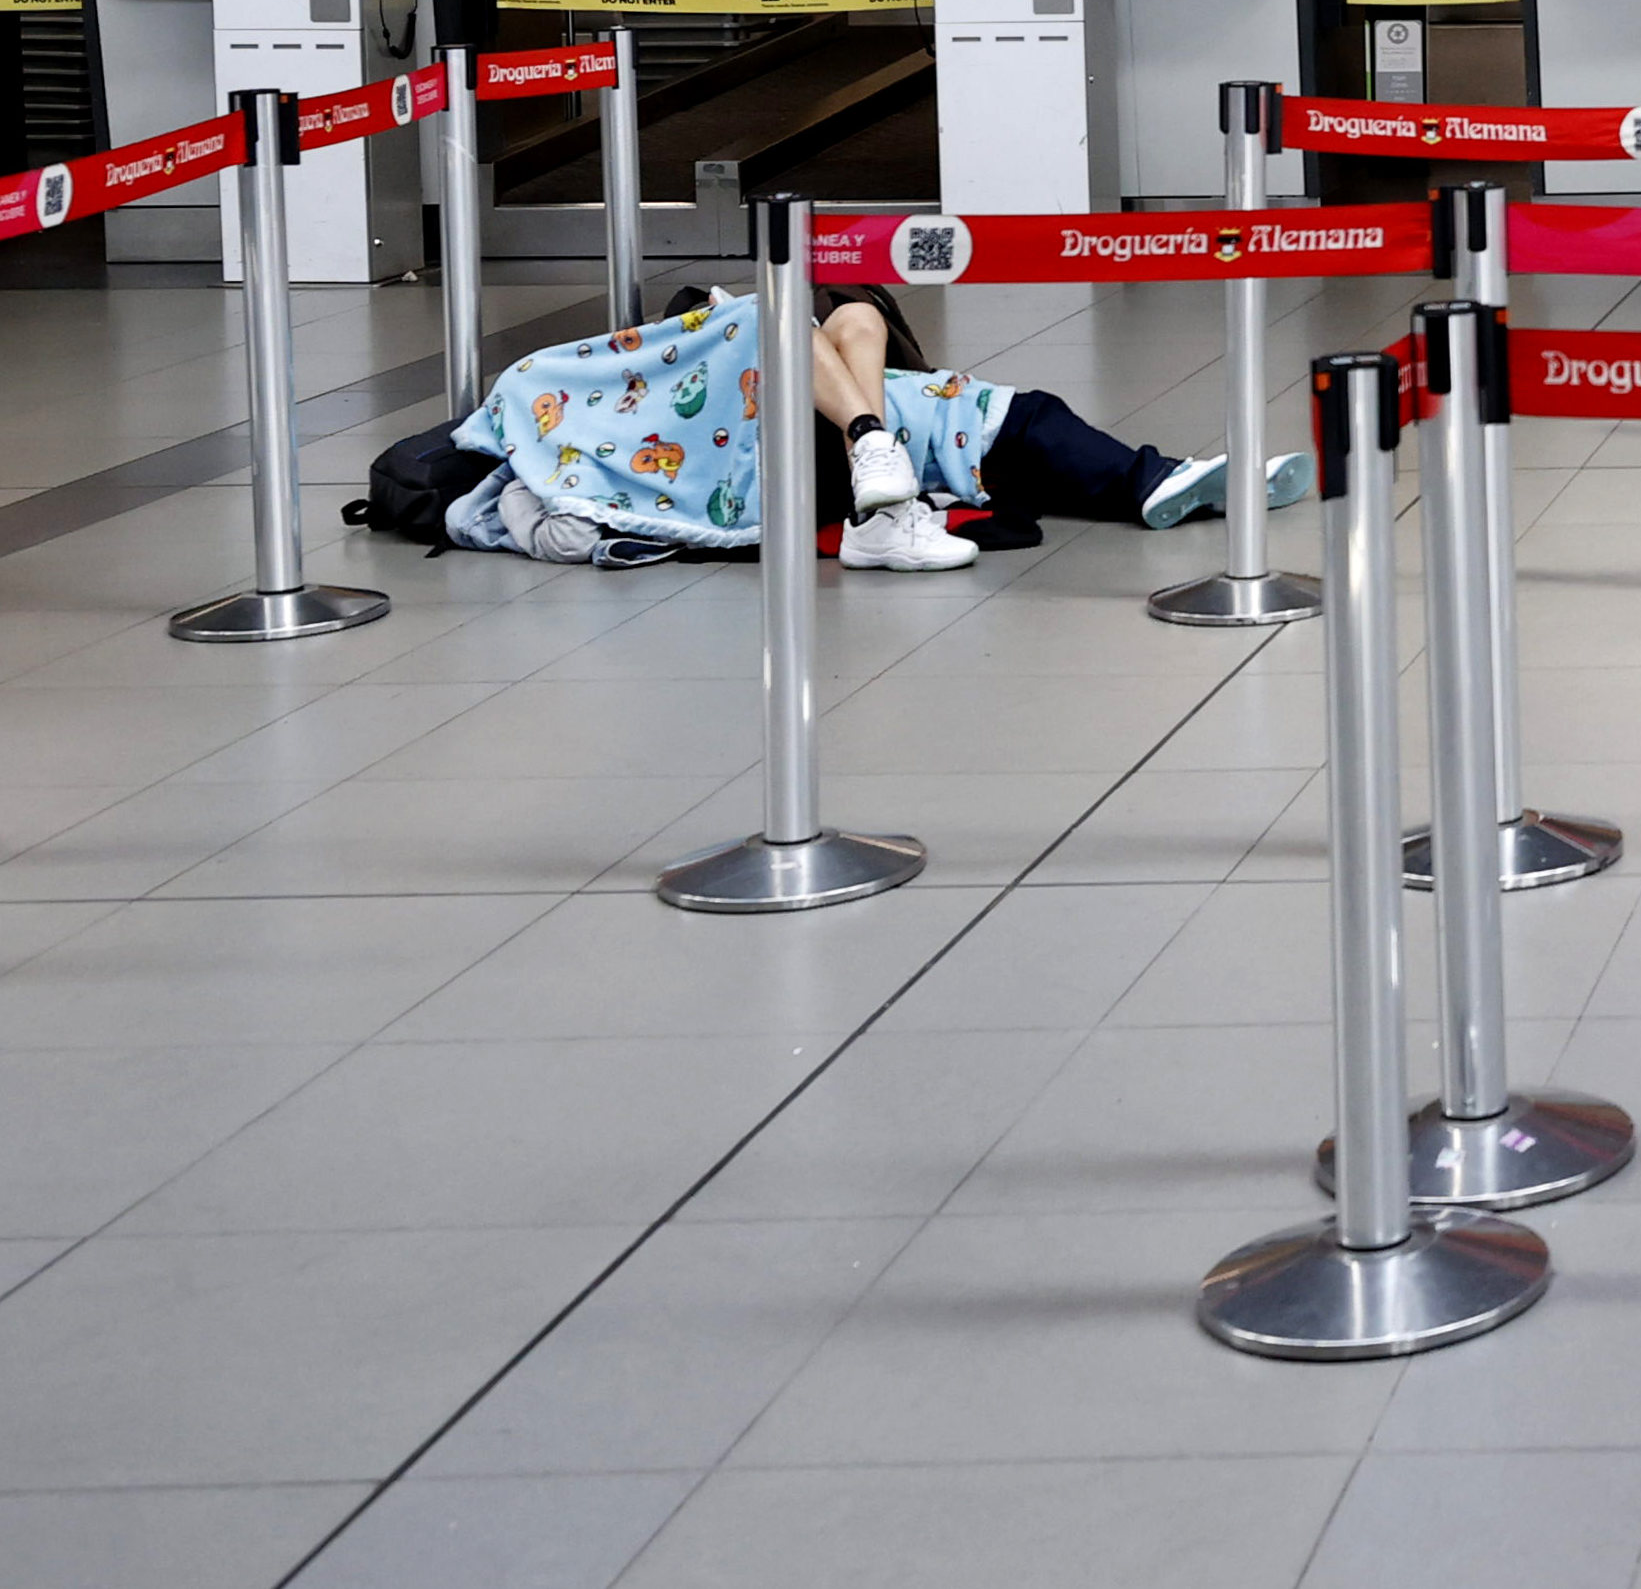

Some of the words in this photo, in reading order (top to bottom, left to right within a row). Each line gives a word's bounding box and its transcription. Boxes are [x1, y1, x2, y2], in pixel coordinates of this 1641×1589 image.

[487, 59, 562, 85] Droguería
[579, 54, 615, 74] Alem
[1305, 109, 1418, 139] Droguería
[1444, 116, 1547, 142] Alemana
[1060, 226, 1209, 262] Droguería
[1248, 224, 1384, 254] Alemana
